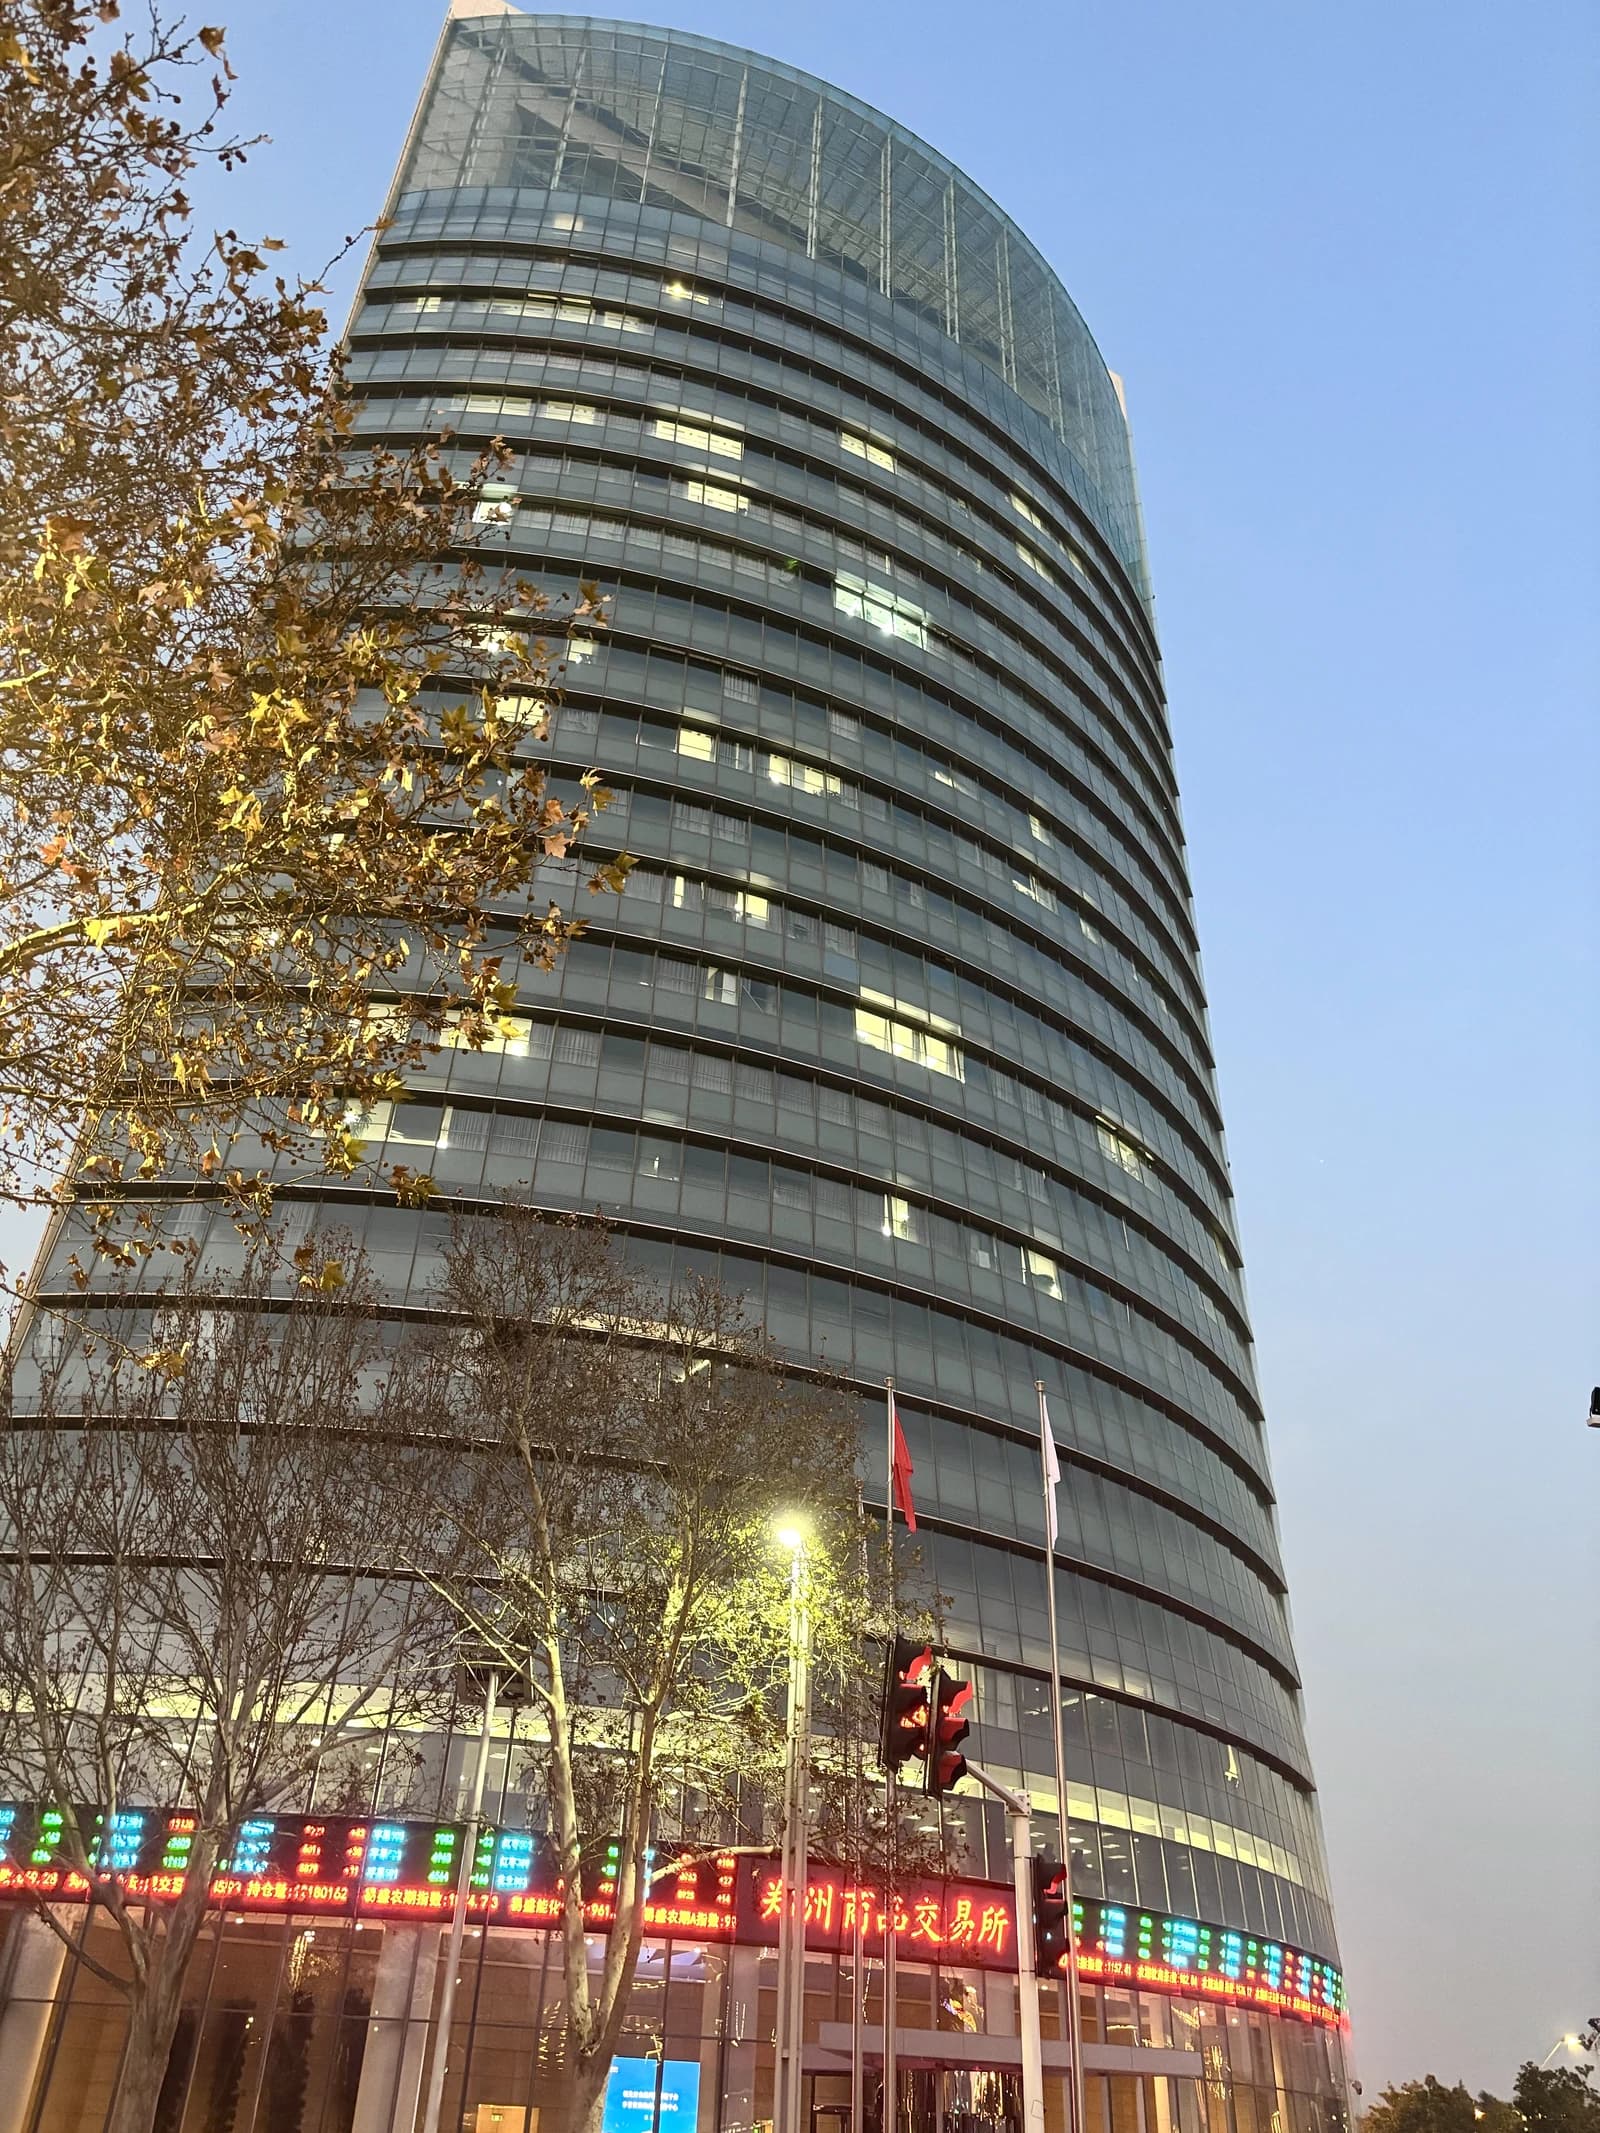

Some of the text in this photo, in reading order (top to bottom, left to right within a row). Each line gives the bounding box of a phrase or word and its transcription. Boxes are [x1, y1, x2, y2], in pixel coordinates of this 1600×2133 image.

[760, 1879, 1010, 1952] 郑州商品交易所
